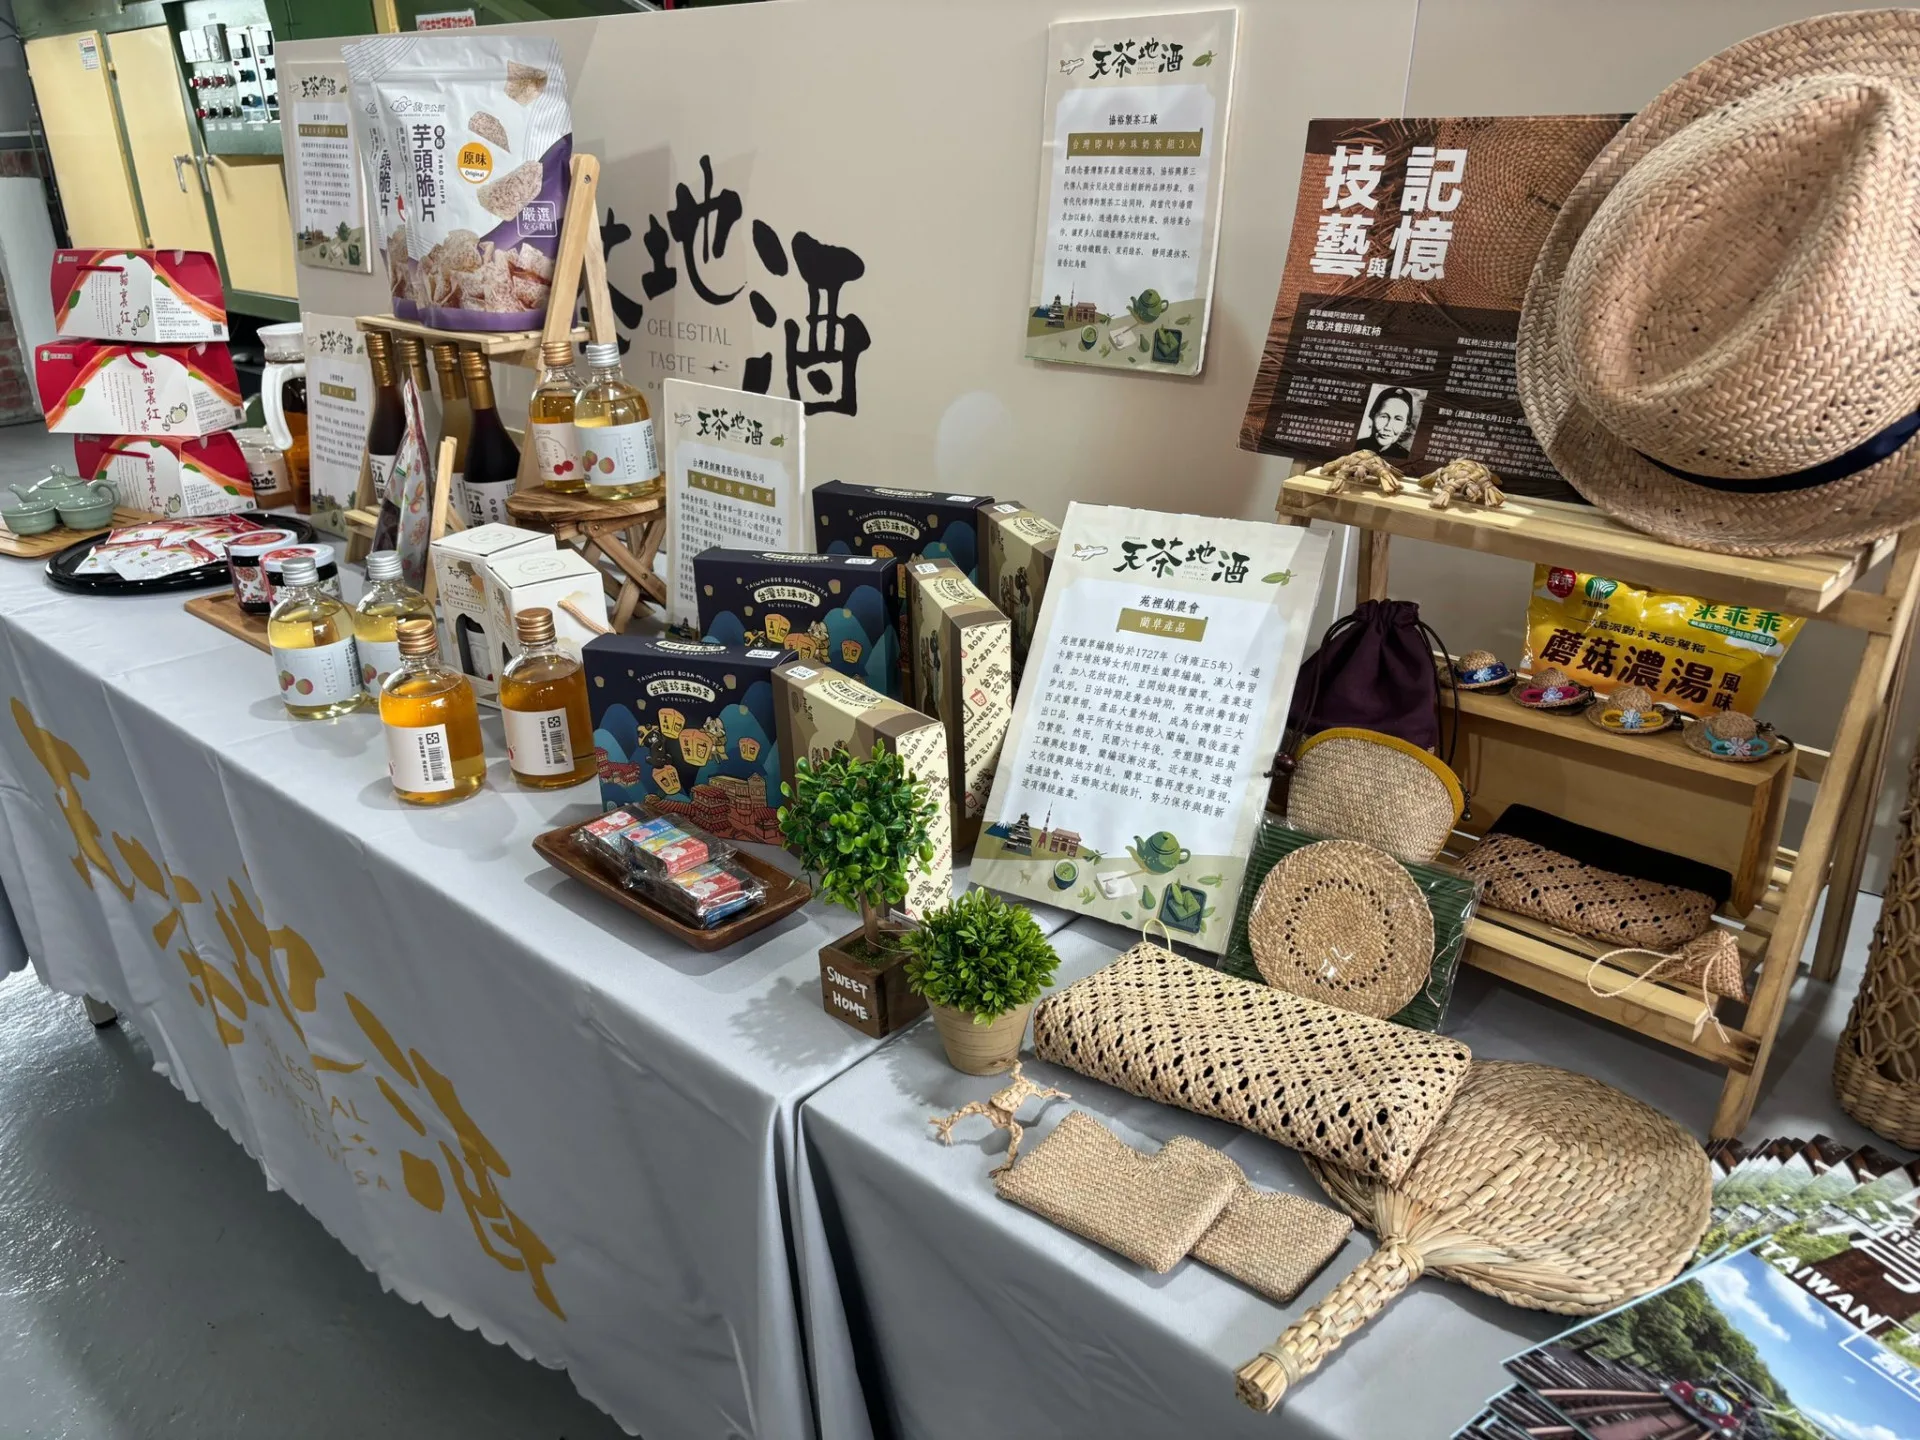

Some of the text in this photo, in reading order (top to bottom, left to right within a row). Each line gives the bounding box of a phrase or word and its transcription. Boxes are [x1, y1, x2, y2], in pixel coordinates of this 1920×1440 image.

[1089, 37, 1183, 80] 天茶地酒
[412, 124, 436, 222] 芋頭脆片
[463, 152, 487, 166] 原味
[464, 169, 485, 178] Original
[522, 206, 551, 223] 嚴選
[646, 317, 732, 347] CELESTIAL
[649, 350, 696, 375] TASTE
[696, 407, 764, 446] 天茶地酒
[865, 520, 916, 536] 台灣珍珠奶茶
[1113, 537, 1251, 584] 天茶地酒
[745, 577, 782, 591] TAIWANESE
[817, 586, 829, 598] TEA
[757, 587, 816, 603] 台灣珍珠奶茶
[1139, 595, 1200, 615] 苑裡鎮農會
[1693, 605, 1783, 633] 米乖乖
[1539, 628, 1714, 704] 蘑菇濃湯
[637, 670, 724, 693] TAIWANESE BOBA MILK TEA
[650, 680, 711, 698] 台灣珍珠奶茶
[1712, 672, 1742, 712] 風味
[826, 965, 869, 1000] SWEET
[832, 991, 869, 1021] HOME
[1760, 1240, 1883, 1328] TAIWAN
